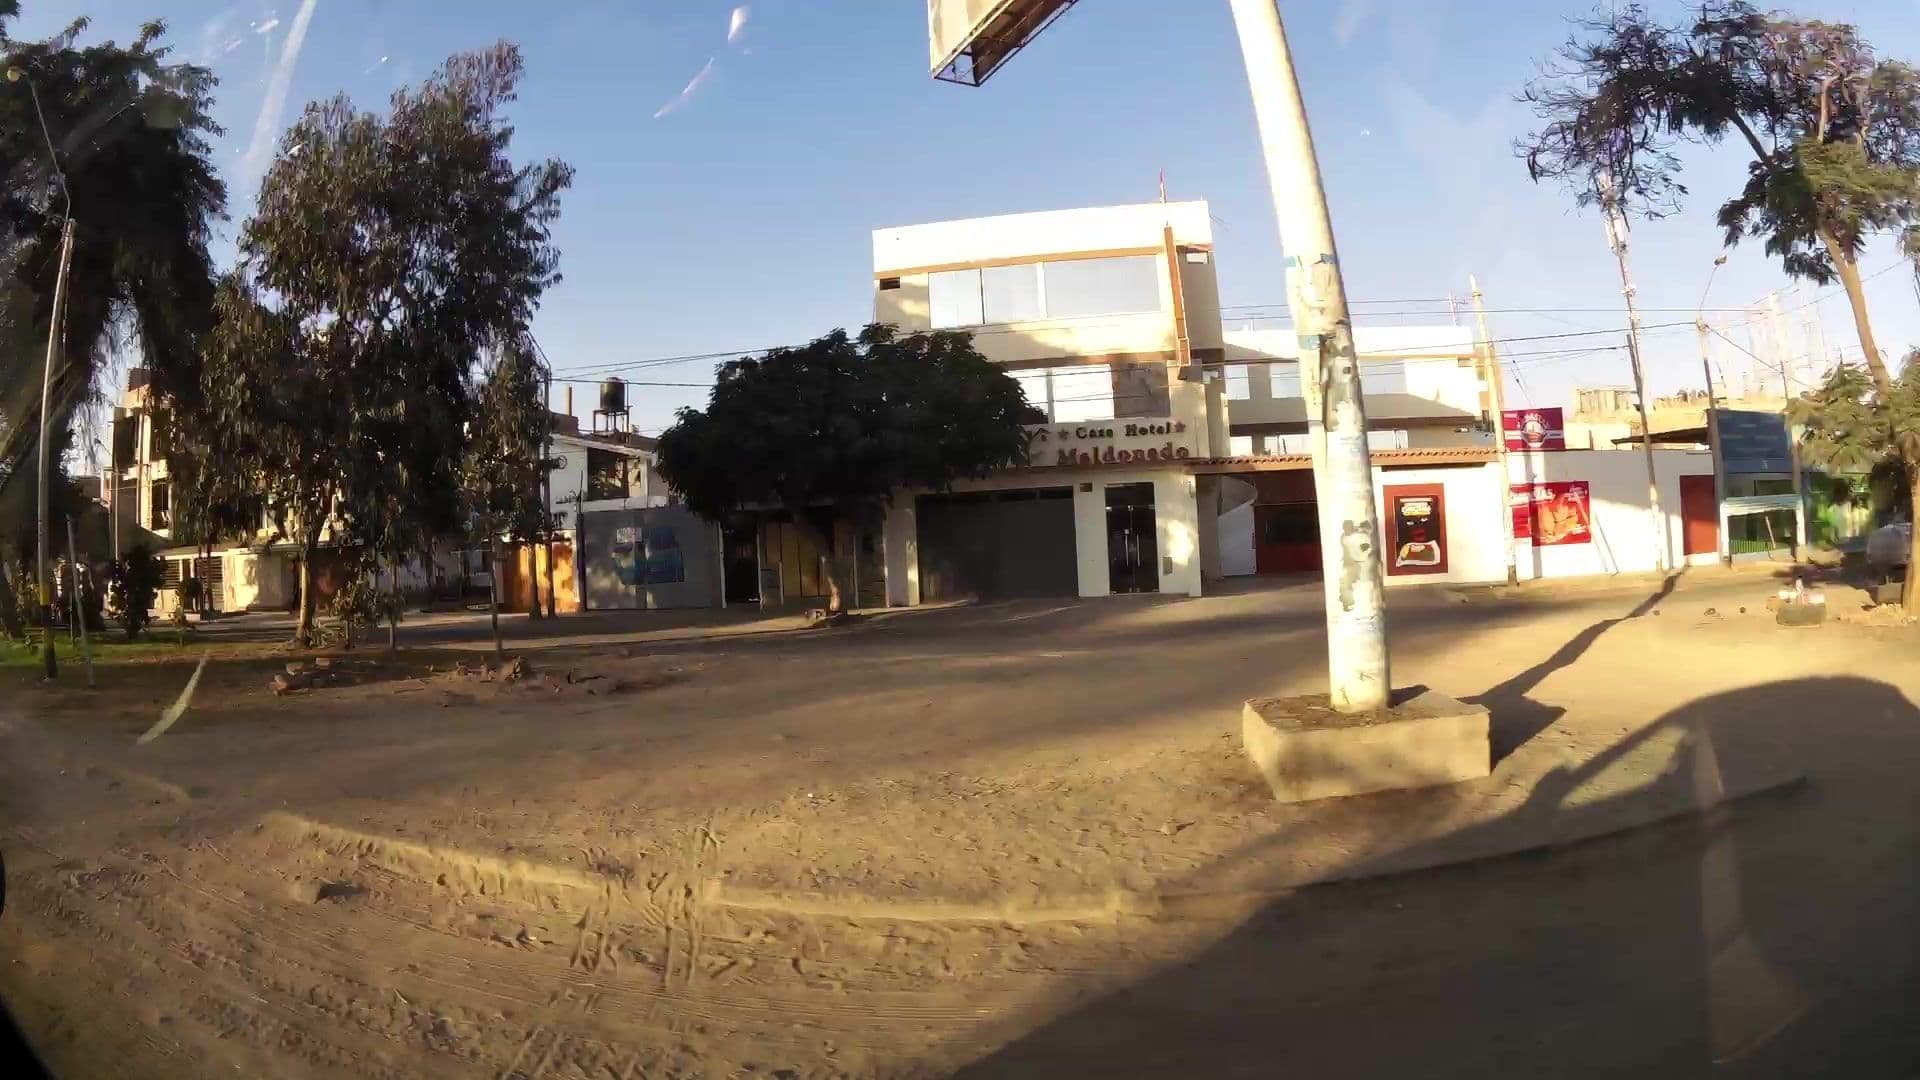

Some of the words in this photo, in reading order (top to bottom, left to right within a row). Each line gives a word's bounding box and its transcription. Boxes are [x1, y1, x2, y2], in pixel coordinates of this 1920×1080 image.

[1075, 426, 1114, 439] Casa
[1125, 421, 1171, 437] Hotel
[1057, 442, 1190, 465] Maldonado
